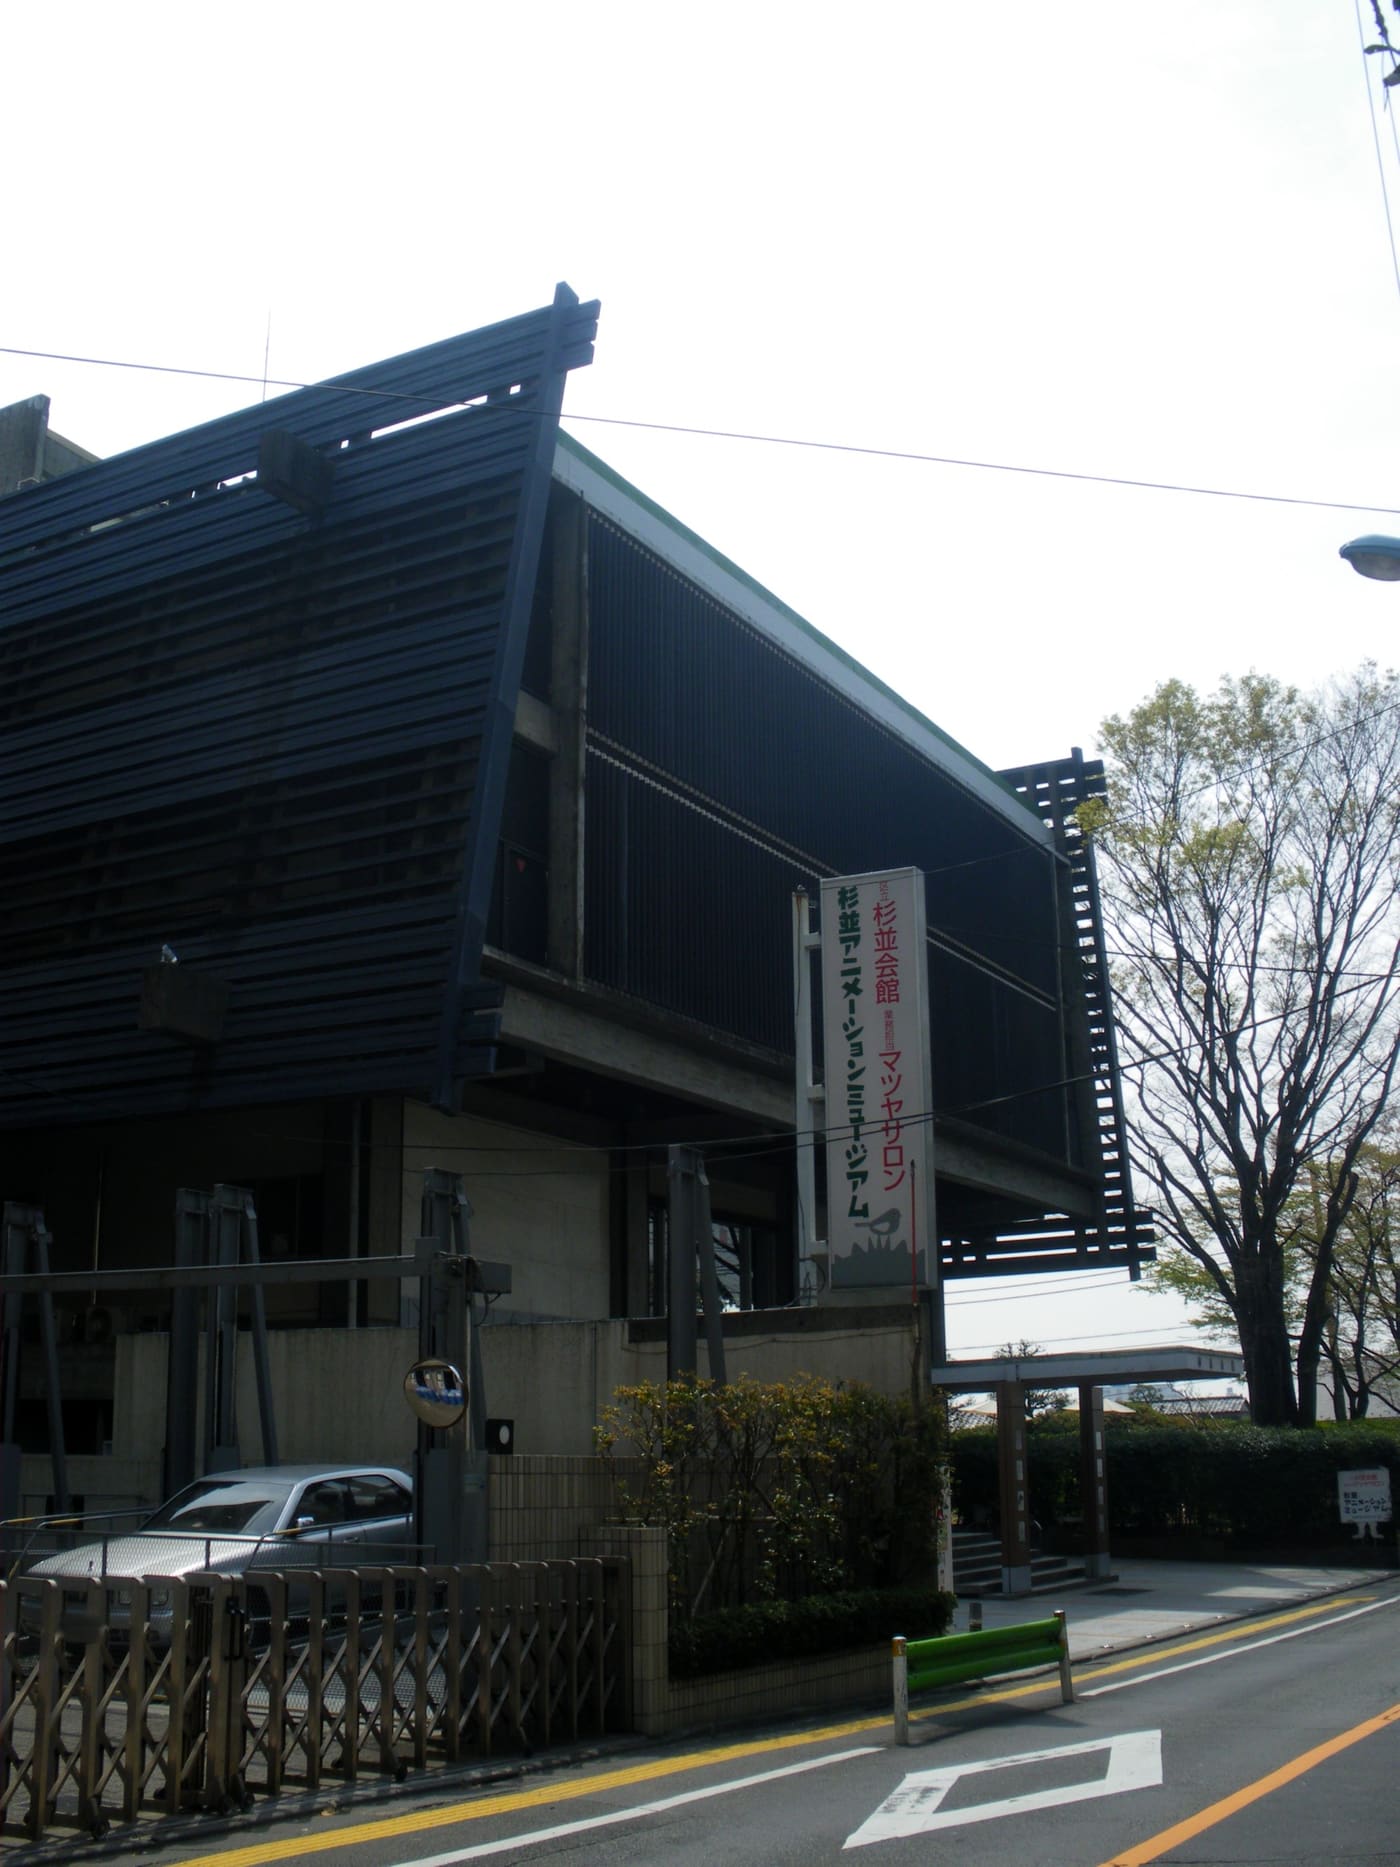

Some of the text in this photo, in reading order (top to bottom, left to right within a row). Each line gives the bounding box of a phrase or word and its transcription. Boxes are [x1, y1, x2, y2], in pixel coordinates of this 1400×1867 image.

[873, 900, 900, 1004] 杉並会館
[838, 886, 869, 1218] 杉並アニメーションミュージアム
[879, 1051, 905, 1191] マツヤサロン
